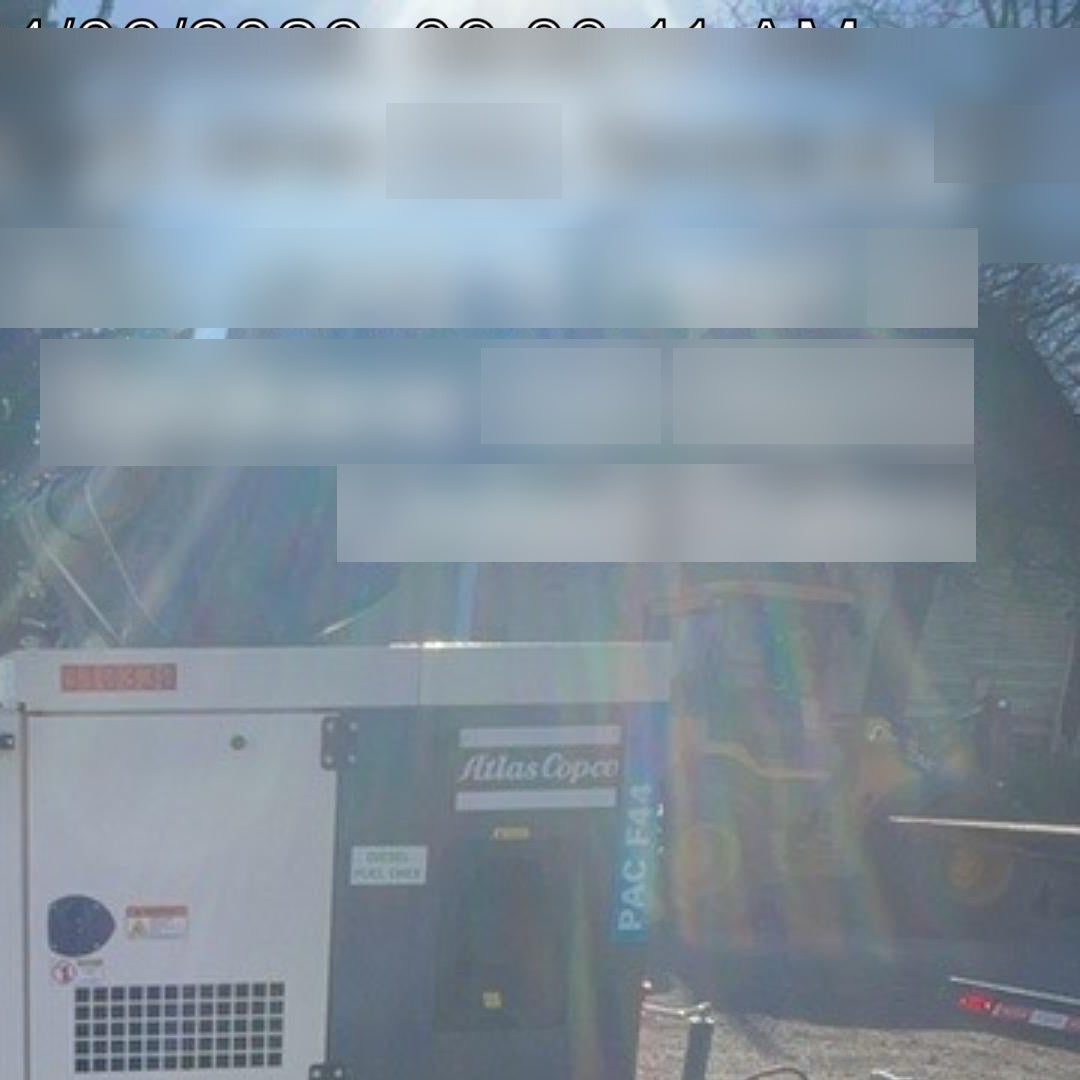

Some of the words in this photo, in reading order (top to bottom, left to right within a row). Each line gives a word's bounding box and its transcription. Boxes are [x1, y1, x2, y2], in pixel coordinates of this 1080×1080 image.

[458, 752, 538, 781] Atlas
[541, 752, 619, 784] Copco
[617, 860, 648, 931] PAC
